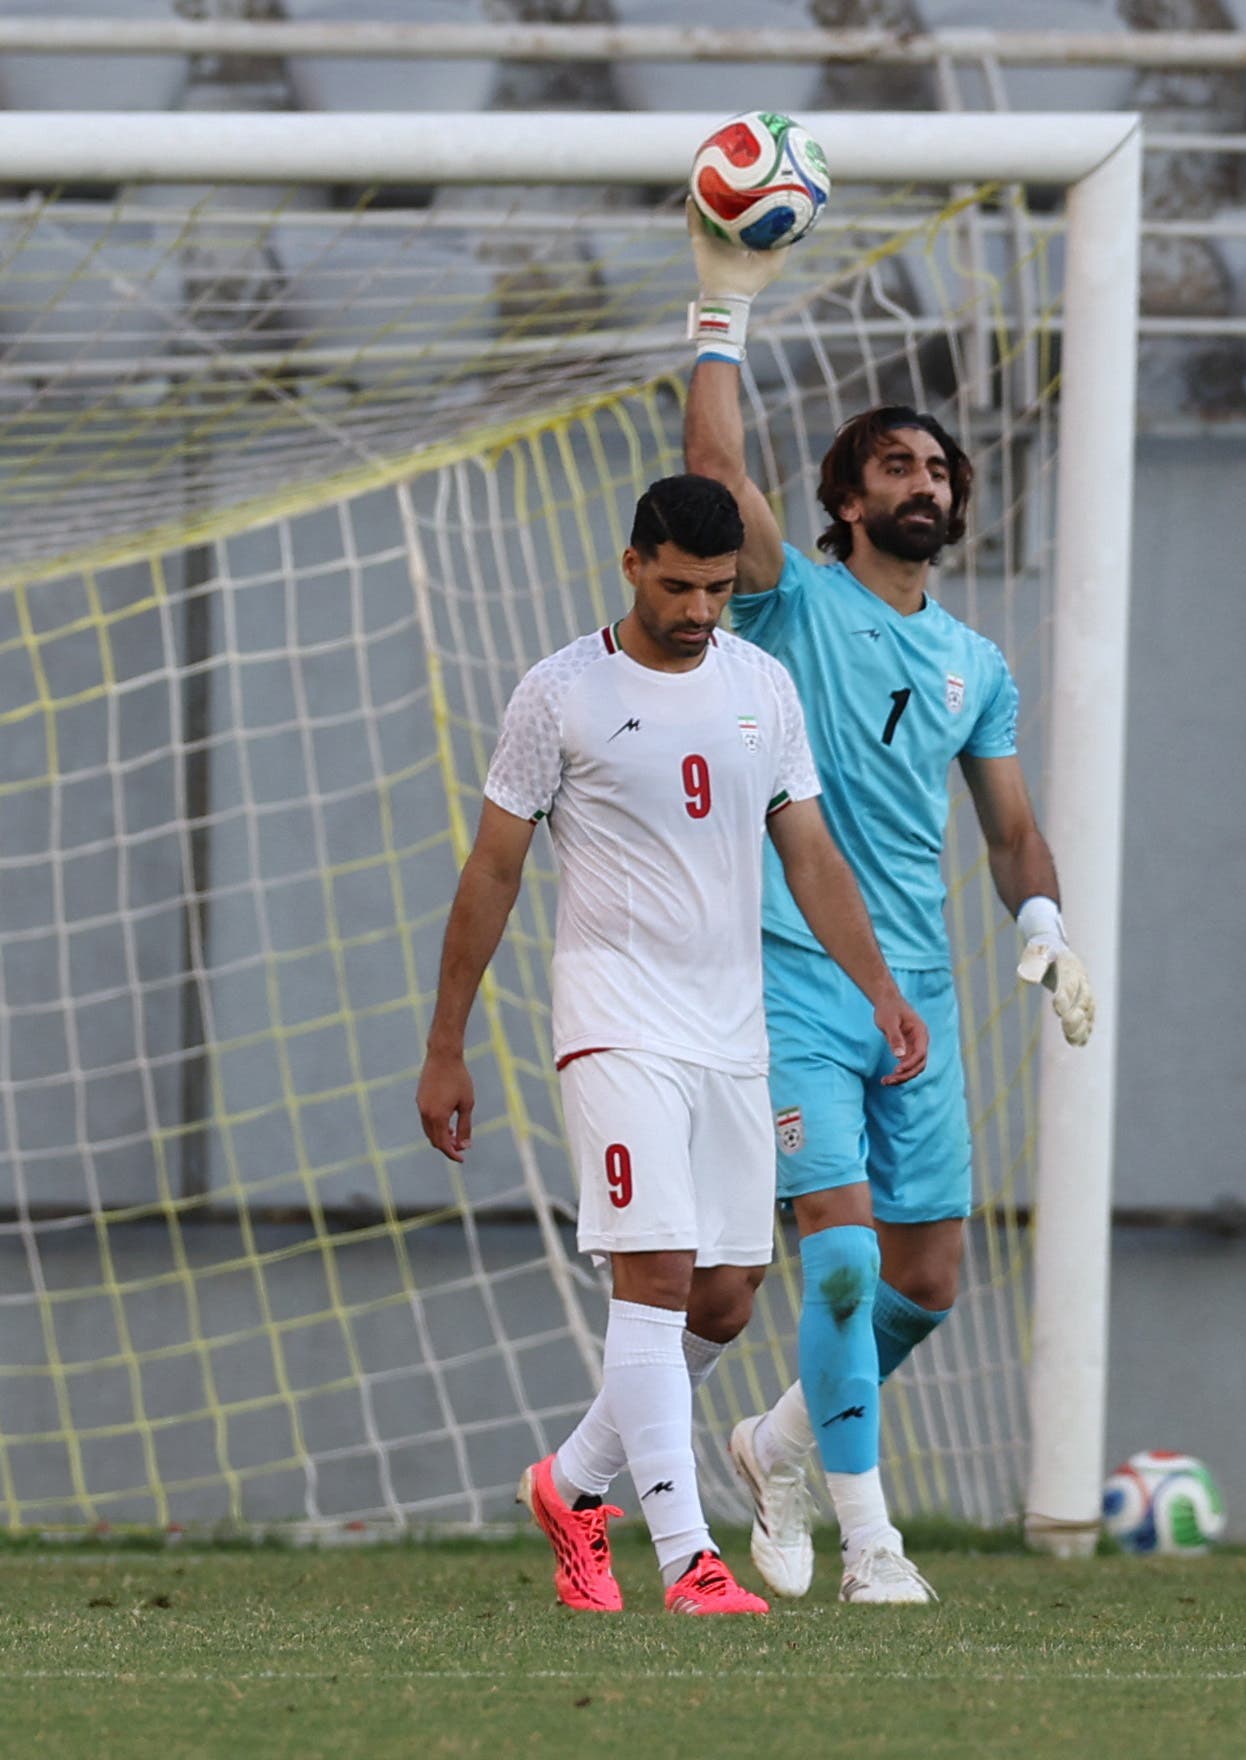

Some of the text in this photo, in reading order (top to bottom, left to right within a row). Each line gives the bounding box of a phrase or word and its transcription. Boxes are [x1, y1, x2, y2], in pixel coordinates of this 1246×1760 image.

[881, 687, 912, 746] 1
[682, 754, 711, 819] 9
[605, 1143, 632, 1209] 9
